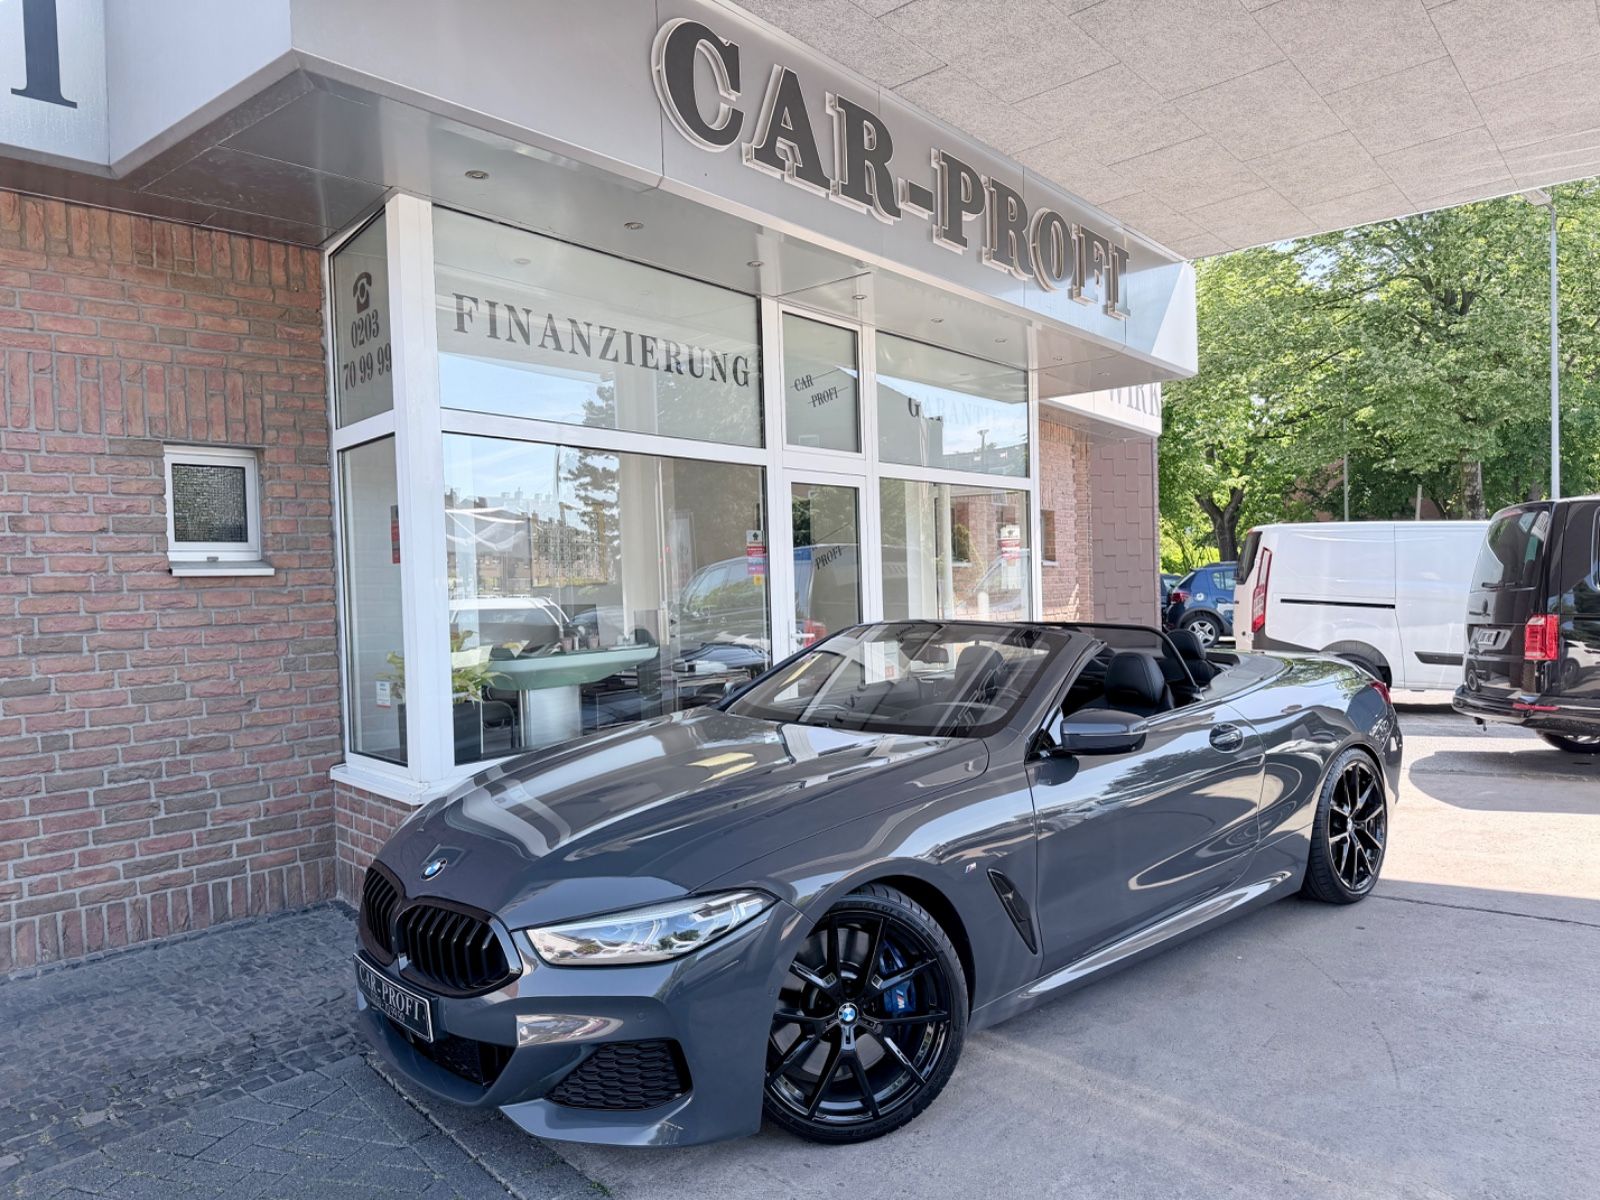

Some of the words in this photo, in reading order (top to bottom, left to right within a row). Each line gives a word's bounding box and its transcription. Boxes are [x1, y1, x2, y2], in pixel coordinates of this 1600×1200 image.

[652, 18, 1130, 320] CAR-PROFI
[351, 309, 380, 349] 0203
[451, 292, 750, 387] FINANZIERUNG
[343, 360, 356, 391] 70
[360, 352, 373, 384] 99
[377, 342, 392, 376] 99
[794, 374, 814, 392] CAR
[811, 386, 838, 408] PROFI
[815, 545, 843, 570] PROFI
